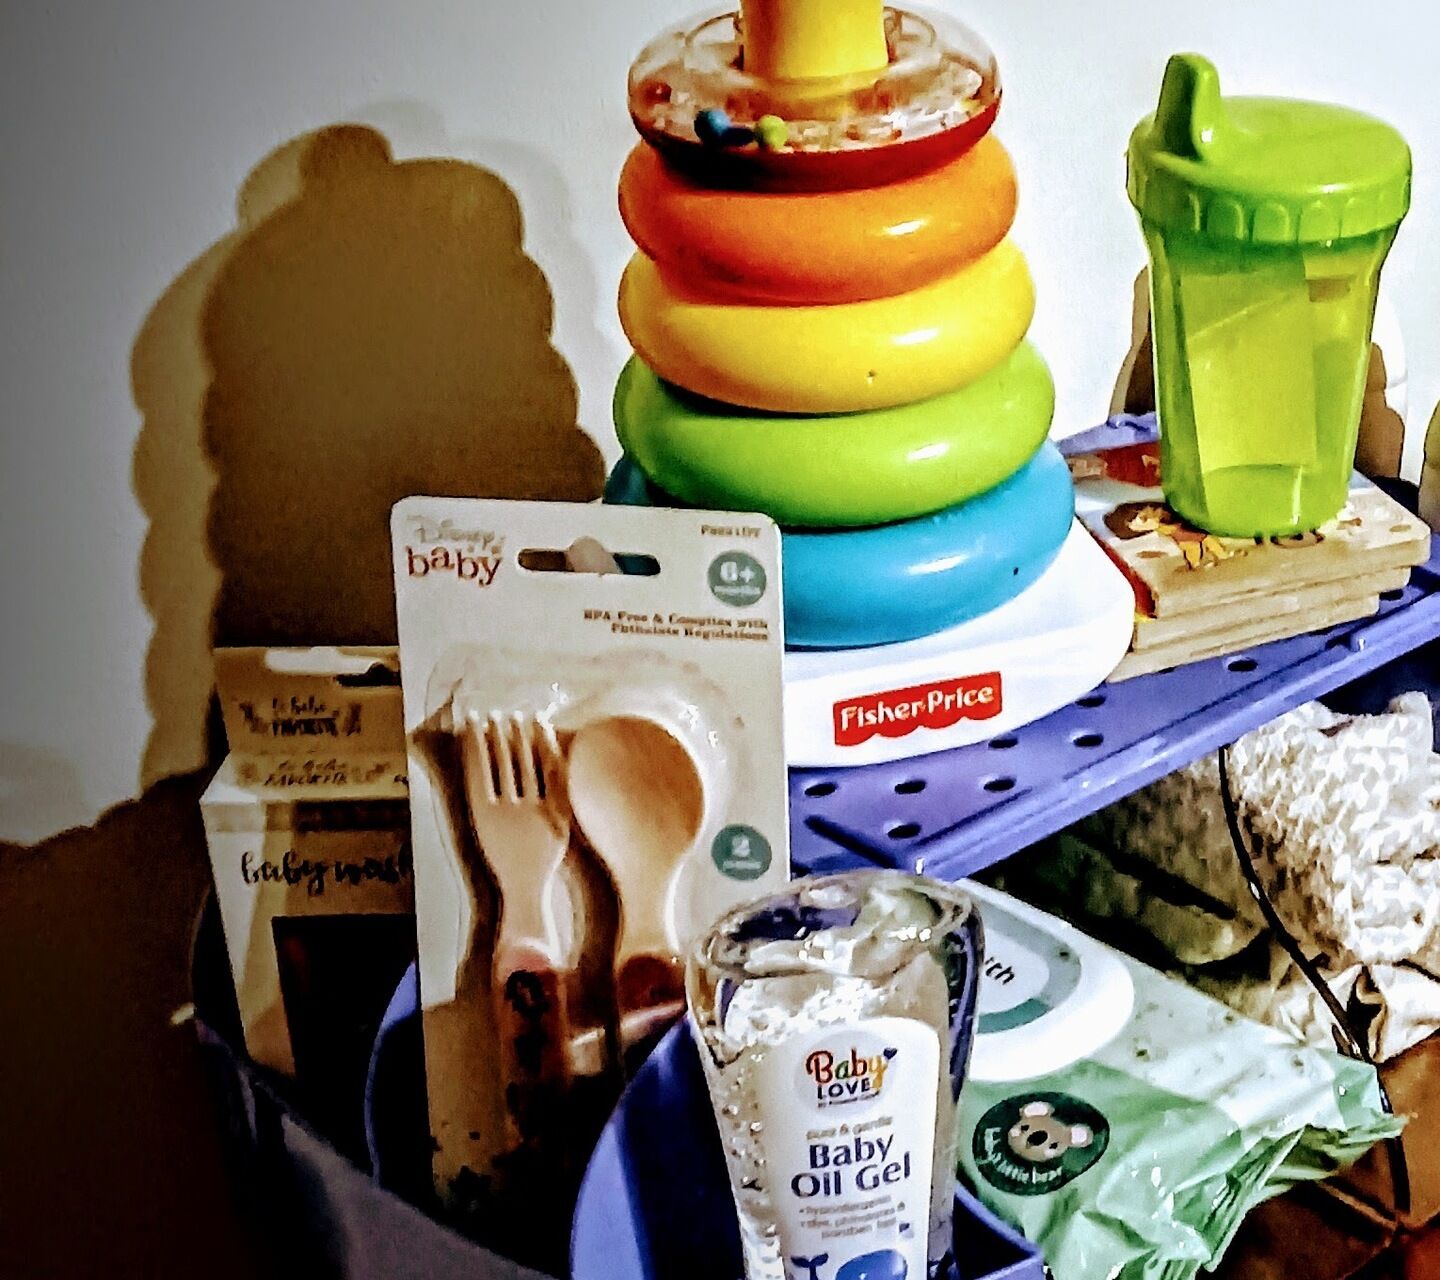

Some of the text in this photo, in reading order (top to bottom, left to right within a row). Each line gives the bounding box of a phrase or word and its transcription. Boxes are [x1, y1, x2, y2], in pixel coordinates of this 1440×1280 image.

[405, 545, 503, 587] baby
[805, 1046, 889, 1090] Baby
[817, 1077, 871, 1100] LOVE
[809, 1134, 894, 1169] Baby
[791, 1151, 911, 1198] Oil Gel
